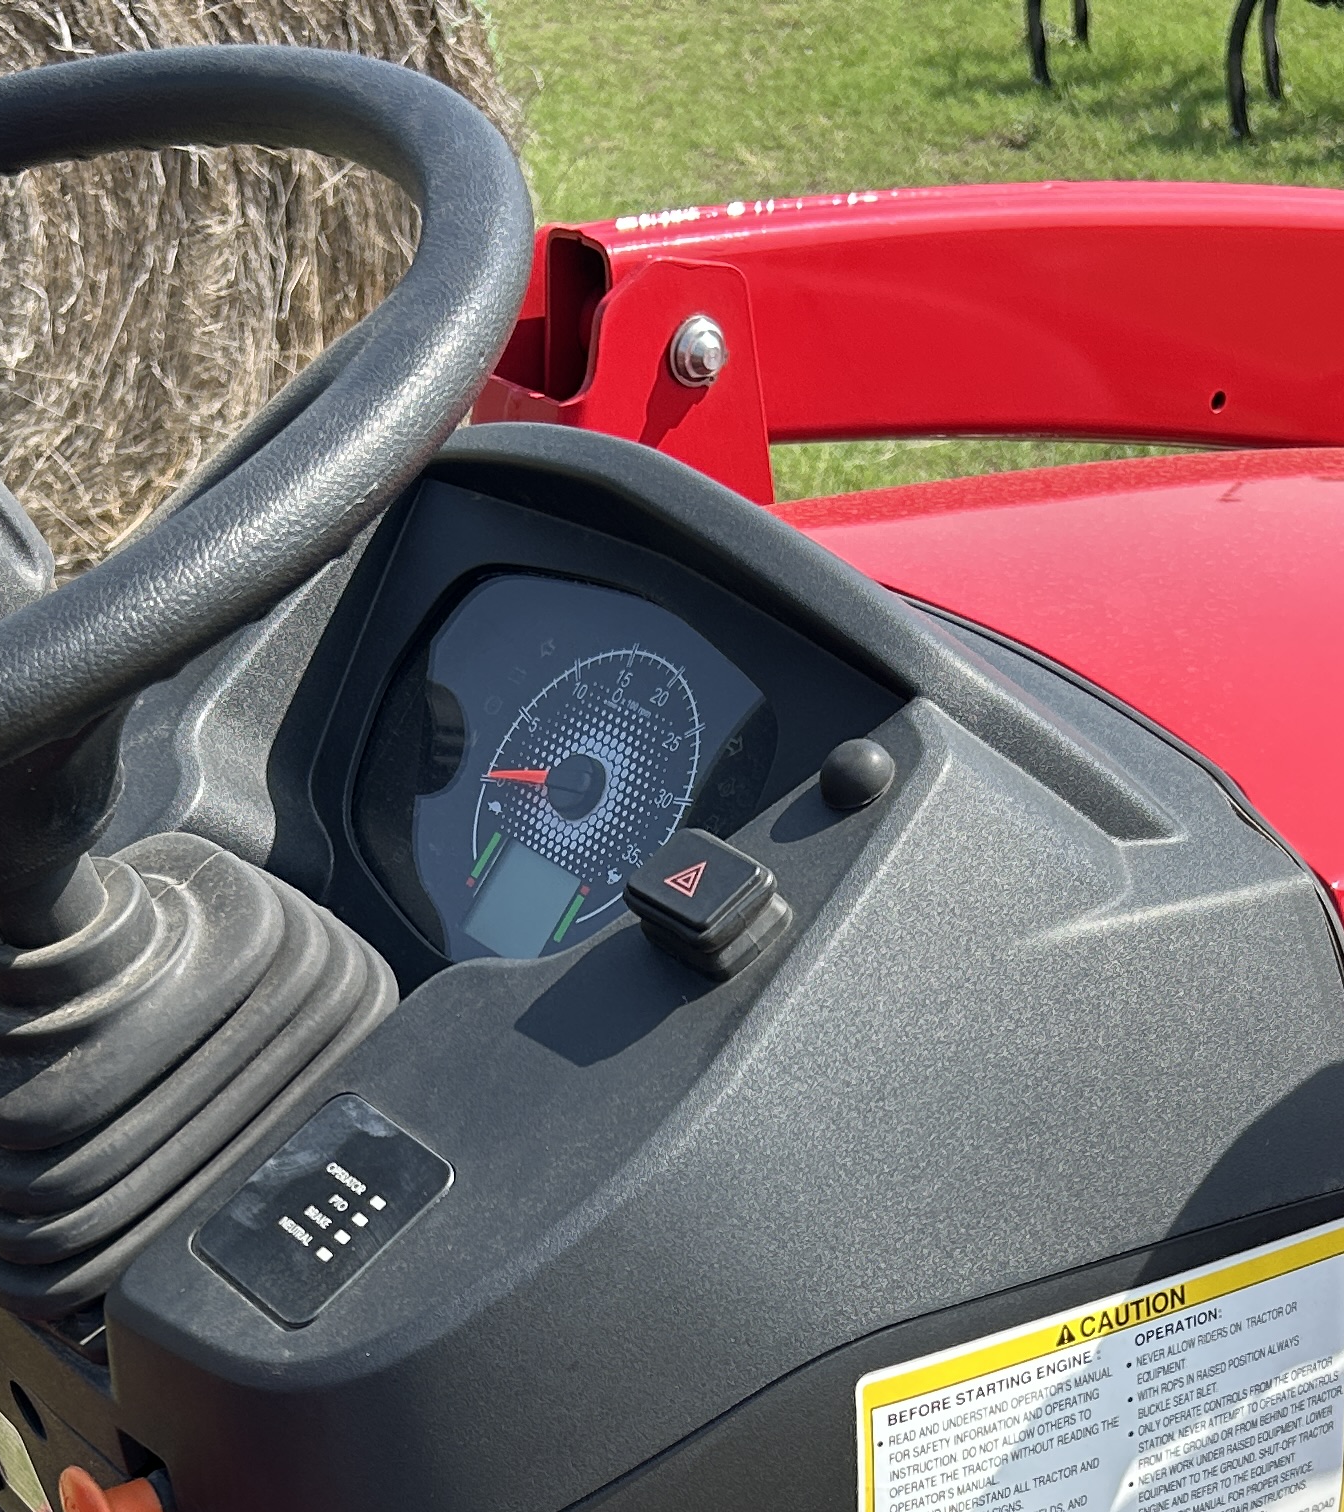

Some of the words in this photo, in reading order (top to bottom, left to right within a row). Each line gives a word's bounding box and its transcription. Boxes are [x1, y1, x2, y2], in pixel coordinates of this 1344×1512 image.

[572, 681, 588, 700] 10
[616, 669, 633, 688] 15
[649, 687, 670, 707] 20
[528, 716, 541, 733] 5
[661, 732, 682, 752] 25
[654, 788, 673, 808] 30
[326, 1162, 367, 1195] OPERATOR
[304, 1205, 333, 1230] BRAKE
[328, 1194, 349, 1212] PTO
[278, 1215, 314, 1247] NEUTRAL
[1080, 1284, 1186, 1338] CAUTION
[1134, 1306, 1222, 1347] OPERATION:
[1136, 1347, 1165, 1367] NEVER
[1166, 1336, 1195, 1356] ALLOW
[1197, 1325, 1228, 1345] RIDERS
[1230, 1320, 1241, 1334] ON
[1246, 1306, 1283, 1328] TRACTOR
[1285, 1301, 1297, 1314] OR
[887, 1395, 951, 1427] BEFORE
[955, 1370, 1031, 1405] STARTING
[888, 1430, 916, 1447] READ
[919, 1422, 939, 1438] AND
[942, 1400, 1007, 1430] UNDERSTAND
[1074, 1366, 1113, 1388] MANUAL
[1137, 1398, 1170, 1420] BUCKLE
[1172, 1390, 1194, 1407] SEAT
[889, 1449, 910, 1465] FOR
[912, 1436, 949, 1458] SAFETY
[953, 1414, 1020, 1445] INFORMATION
[1023, 1407, 1042, 1422] AND
[1045, 1388, 1099, 1415] OPERATING
[962, 1445, 976, 1459] DO
[979, 1438, 998, 1454] NOT
[1002, 1427, 1034, 1446] ALLOW
[1037, 1413, 1075, 1435] OTHERS
[1078, 1408, 1091, 1422] TO
[889, 1474, 937, 1500] OPERATE
[941, 1467, 958, 1483] THE
[962, 1451, 1008, 1476] TRACTOR
[1010, 1437, 1054, 1461] WITHOUT
[1057, 1422, 1099, 1446] READING
[1102, 1416, 1119, 1431] THE
[1013, 1479, 1030, 1494] ALL
[1032, 1464, 1077, 1488] TRACTOR
[1079, 1457, 1099, 1473] AND
[1068, 1494, 1087, 1510] AND
